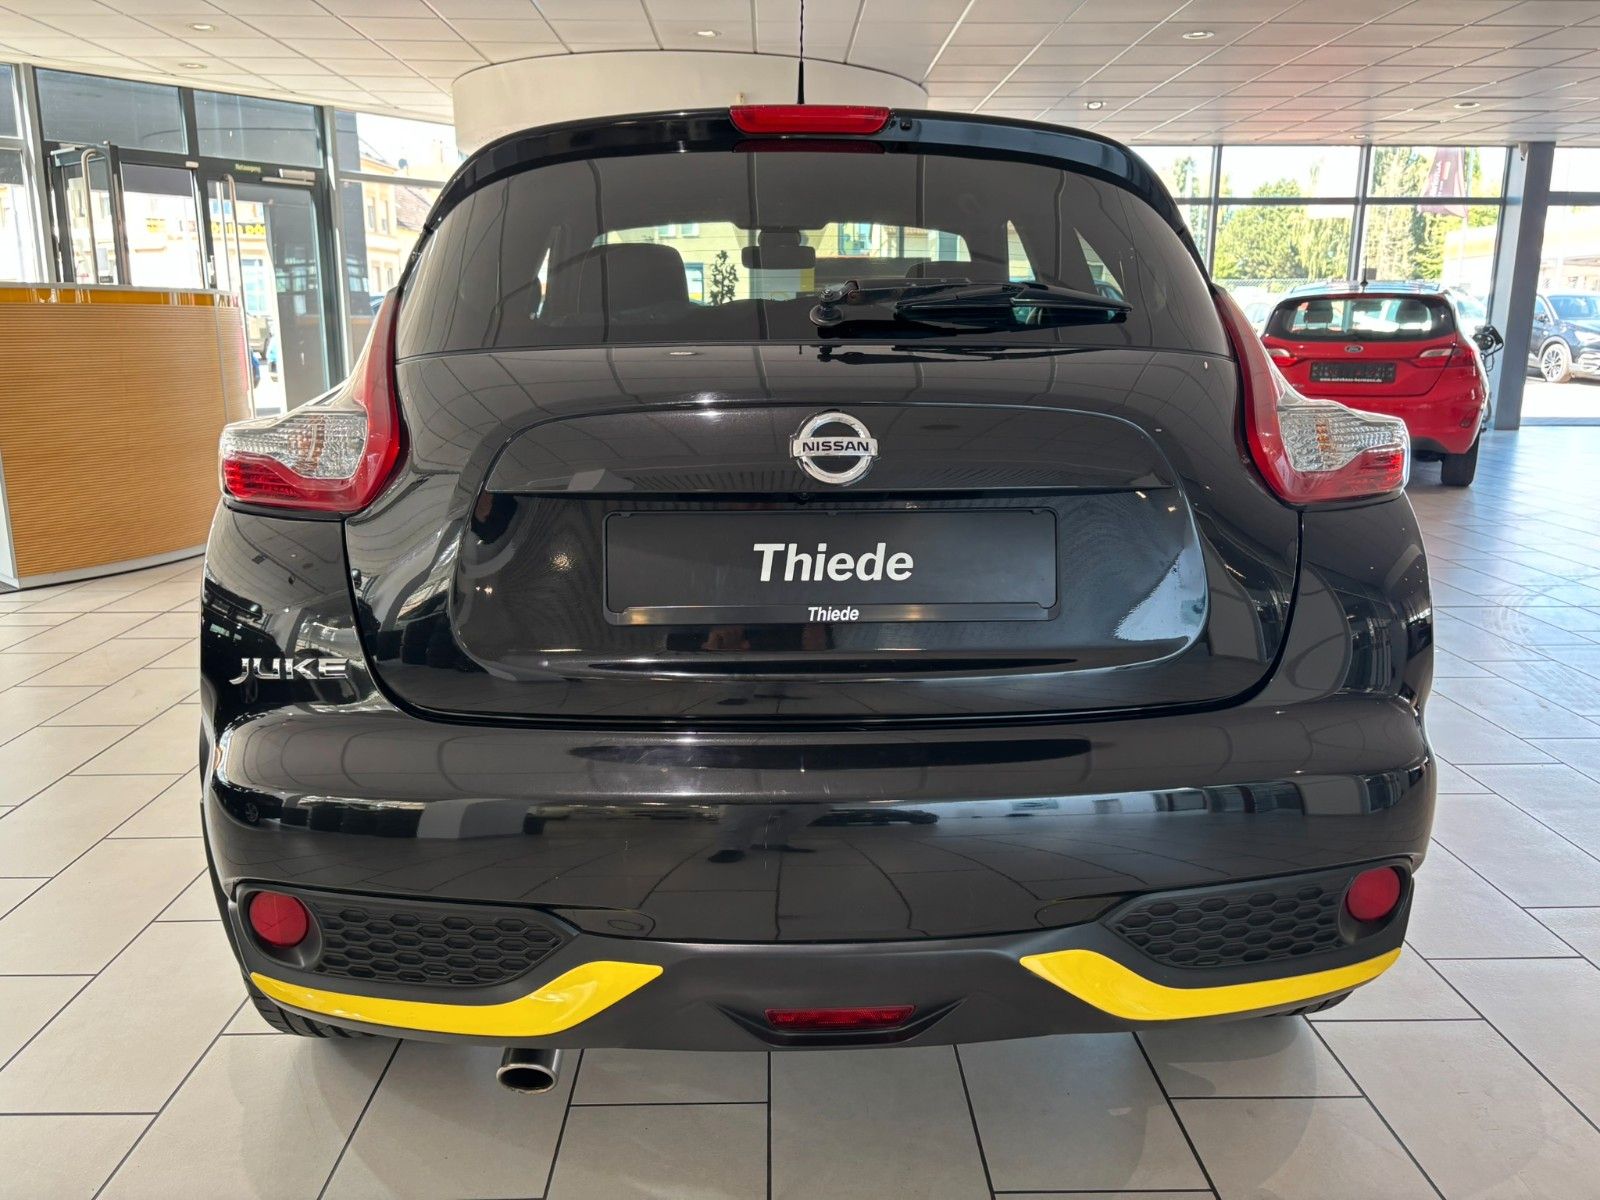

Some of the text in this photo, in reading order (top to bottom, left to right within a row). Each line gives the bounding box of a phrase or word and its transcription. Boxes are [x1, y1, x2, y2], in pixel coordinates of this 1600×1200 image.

[802, 440, 869, 452] NISSAN
[753, 542, 914, 582] Thiede
[807, 606, 860, 622] Thiede
[229, 658, 349, 684] JUKE
